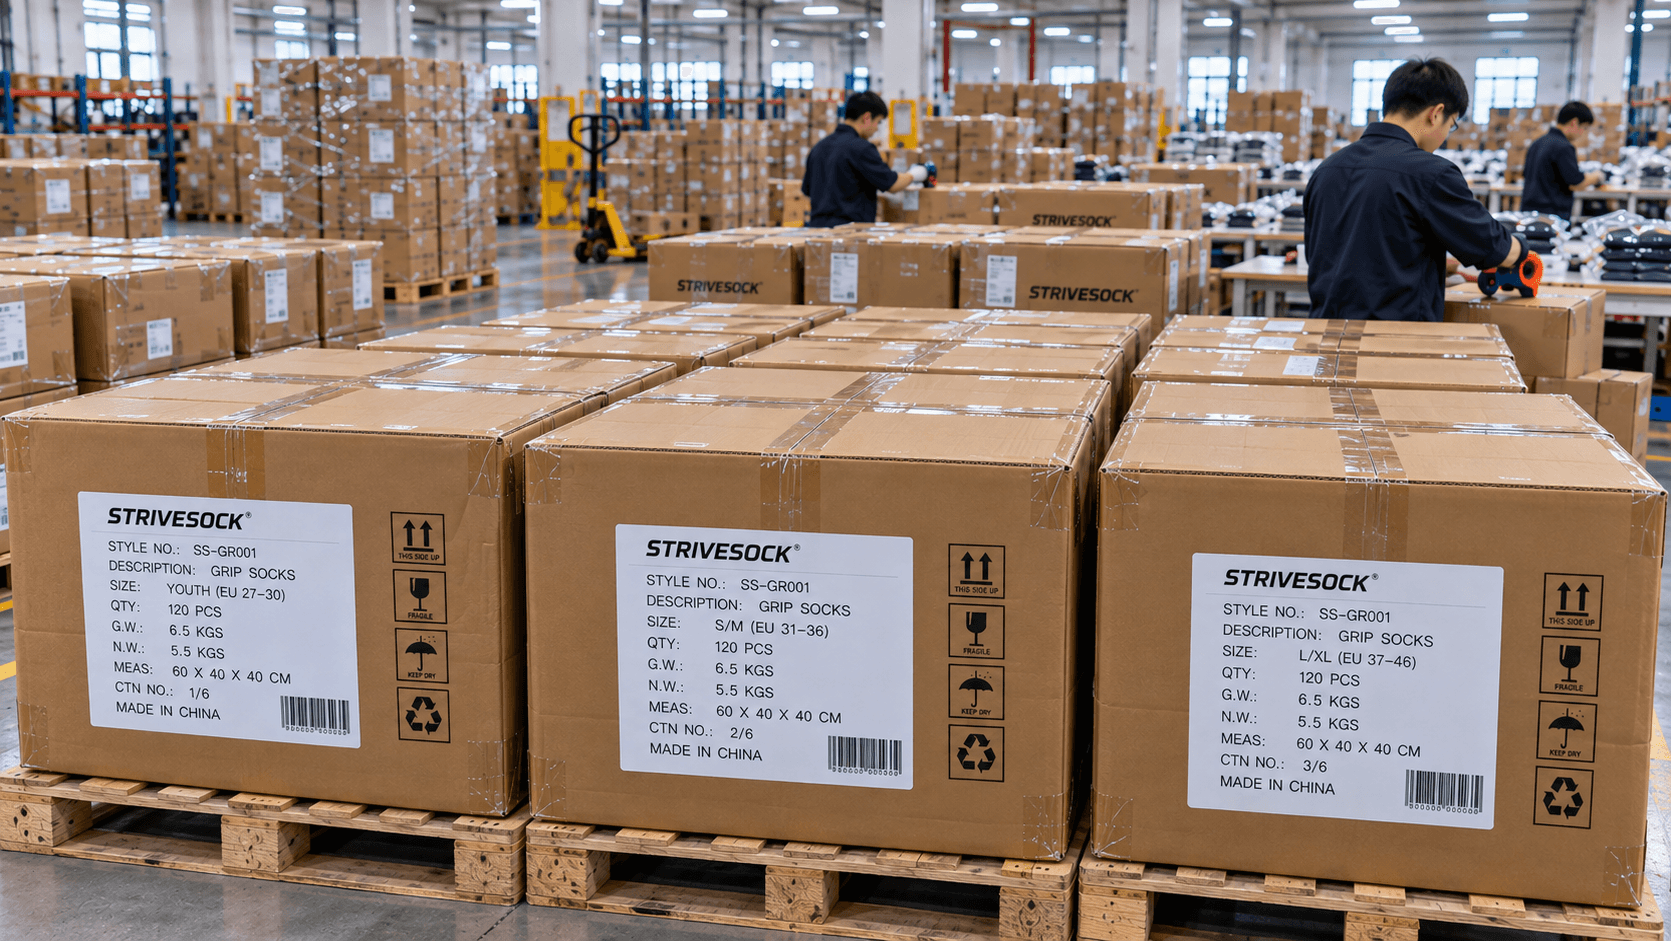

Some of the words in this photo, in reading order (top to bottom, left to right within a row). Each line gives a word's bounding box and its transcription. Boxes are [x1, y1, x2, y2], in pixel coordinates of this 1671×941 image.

[108, 540, 147, 553] STYLE
[154, 543, 179, 555] NO.:
[194, 544, 256, 558] SS-GR001
[109, 560, 195, 575] DESCRIPTION:
[211, 565, 242, 577] GRIP
[249, 567, 295, 581] SOCKS
[110, 580, 140, 592] SIZE:
[167, 583, 210, 596] YOUTH
[216, 586, 237, 599] (EU
[242, 588, 285, 603] 27-30)
[647, 574, 690, 588] STYLE
[697, 577, 725, 589] NO.:
[741, 579, 809, 593] SS-GR001
[972, 586, 987, 594] SIDE
[111, 600, 140, 612] QTY:
[168, 604, 189, 616] 120
[196, 605, 222, 618] PCS
[647, 595, 742, 611] DESCRIPTION:
[759, 600, 793, 613] GRIP
[801, 603, 851, 617] SOCKS
[1224, 603, 1268, 617] STYLE
[1275, 606, 1304, 618] NO.:
[1319, 608, 1389, 623] SS-GR001
[408, 612, 433, 620] FRAGILE
[1549, 617, 1565, 625] THIS
[1567, 617, 1583, 626] SIDE
[112, 620, 142, 633] G.W.:
[170, 624, 190, 636] 6.5
[196, 626, 223, 638] KGS
[647, 615, 680, 628] SIZE:
[715, 619, 743, 632] S/M
[751, 620, 774, 635] (EU
[781, 623, 828, 639] 31-36)
[1223, 624, 1321, 640] DESCRIPTION:
[1339, 630, 1373, 643] GRIP
[1381, 633, 1433, 647] SOCKS
[113, 641, 144, 653] N.W.:
[171, 645, 191, 657] 5.5
[198, 647, 224, 659] KGS
[647, 637, 679, 649] QTY:
[715, 641, 737, 653] 120
[745, 642, 773, 655] PCS
[1223, 645, 1257, 658] SIZE:
[1300, 650, 1332, 663] L/XL
[1338, 651, 1362, 665] (EU
[1368, 654, 1416, 670] 37-46)
[114, 661, 153, 674] MEAS:
[173, 666, 188, 677] 60
[194, 667, 203, 678] X
[210, 668, 225, 680] 40
[232, 670, 240, 681] X
[247, 671, 263, 683] 40
[270, 672, 291, 684] CM
[648, 658, 682, 671] G.W.:
[716, 662, 737, 675] 6.5
[745, 664, 774, 677] KGS
[1222, 666, 1255, 679] QTY:
[1300, 672, 1323, 684] 120
[1330, 673, 1360, 687] PCS
[115, 681, 140, 694] CTN
[147, 684, 173, 696] NO.:
[190, 687, 209, 700] 1/6
[649, 679, 683, 692] N.W.:
[716, 684, 737, 696] 5.5
[745, 686, 774, 698] KGS
[1555, 683, 1584, 692] FRAGILE
[1222, 688, 1256, 702] G.W.:
[1299, 693, 1322, 706] 6.5
[1330, 695, 1360, 709] KGS
[116, 701, 154, 715] MADE
[160, 705, 172, 716] IN
[179, 706, 221, 720] CHINA
[649, 701, 692, 714] MEAS:
[717, 705, 733, 717] 60
[740, 706, 749, 718] X
[756, 708, 772, 720] 40
[779, 709, 788, 720] X
[795, 710, 812, 722] 40
[819, 711, 841, 723] CM
[1222, 711, 1257, 724] N.W.:
[1298, 716, 1321, 728] 5.5
[1329, 718, 1359, 731] KGS
[649, 722, 677, 734] CTN
[685, 724, 712, 736] NO.:
[731, 727, 753, 740] 2/6
[650, 742, 691, 756] MADE
[698, 746, 710, 758] IN
[718, 747, 762, 761] CHINA
[1222, 732, 1265, 746] MEAS:
[1297, 738, 1313, 750] 60
[1319, 739, 1329, 751] X
[1335, 740, 1352, 752] 40
[1358, 741, 1368, 753] X
[1374, 743, 1391, 755] 40
[1398, 744, 1420, 757] CM
[1221, 753, 1249, 767] CTN
[1256, 756, 1284, 769] NO.:
[1303, 760, 1327, 773] 3/6
[1221, 775, 1262, 789] MADE
[1269, 779, 1282, 791] IN
[1289, 780, 1335, 795] CHINA
